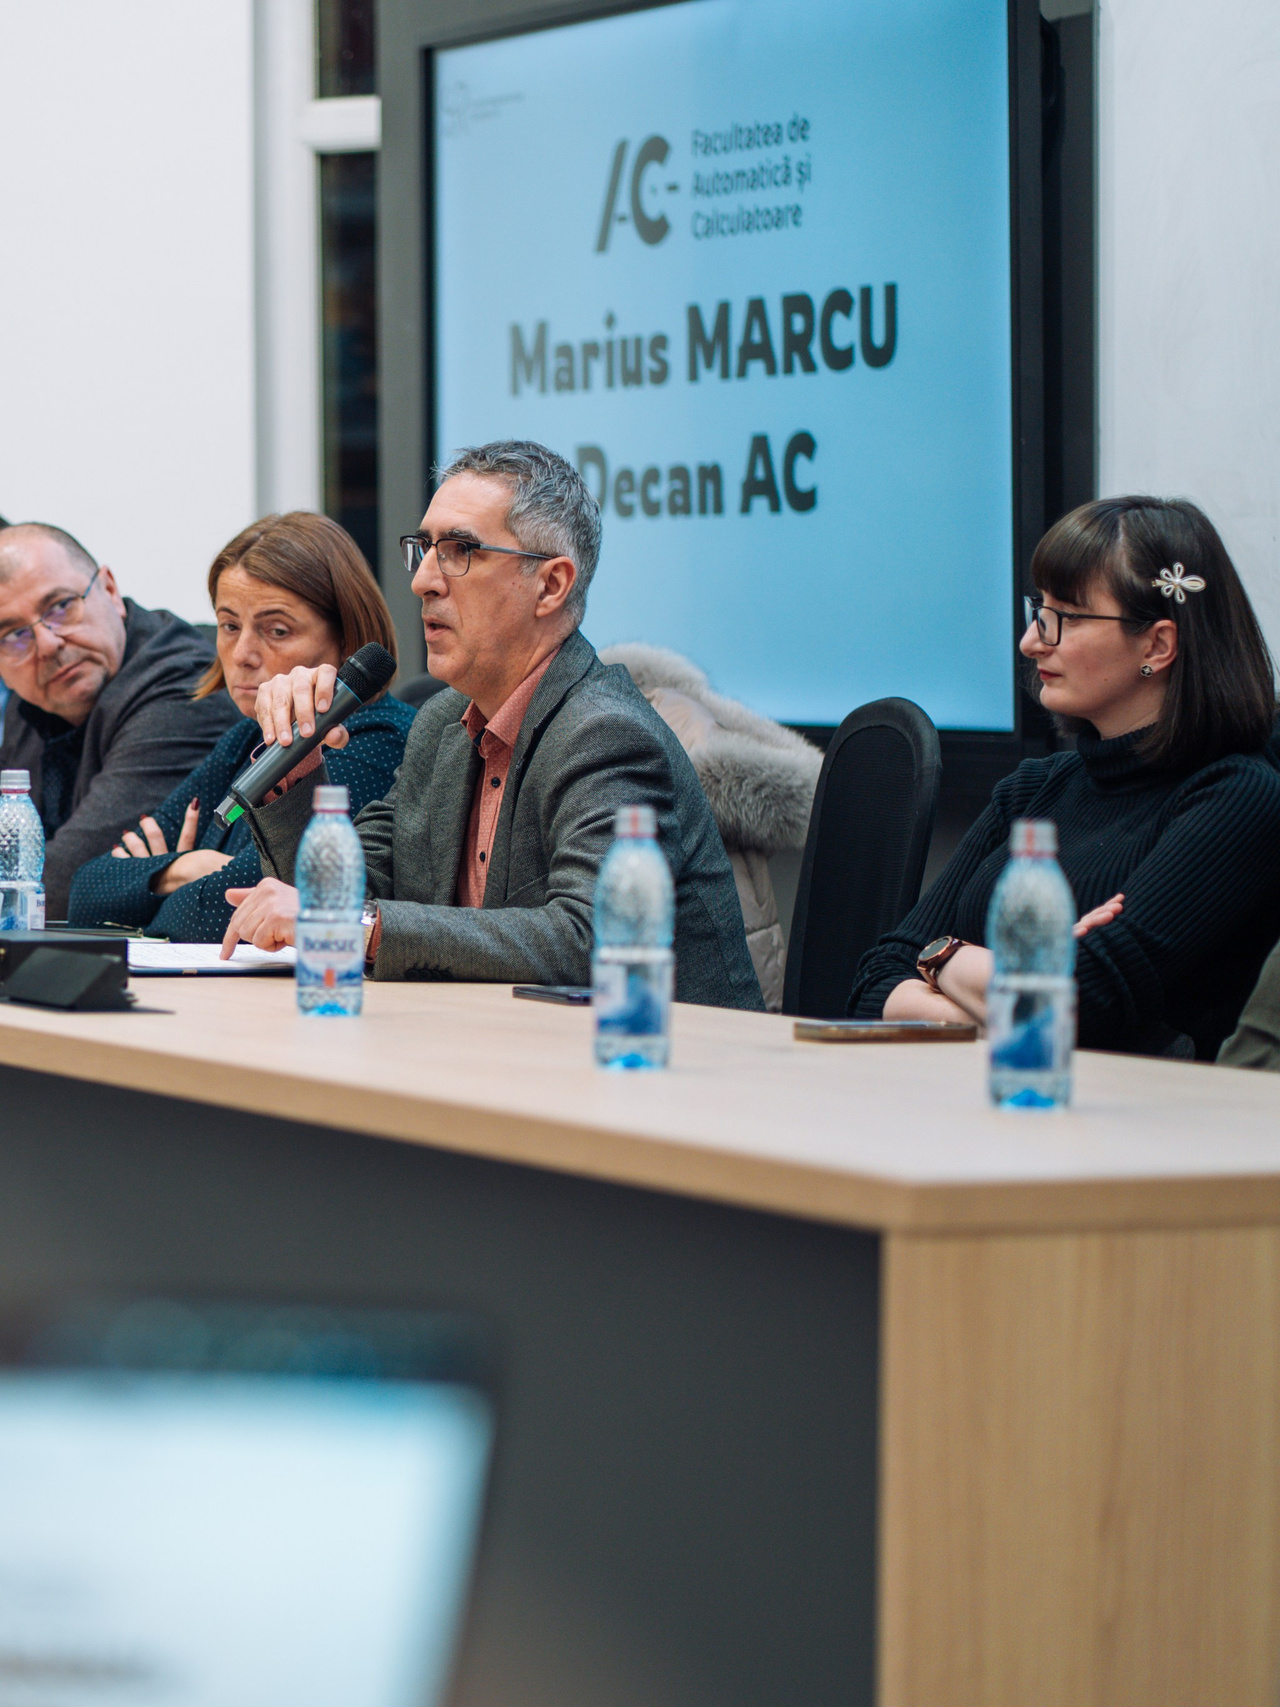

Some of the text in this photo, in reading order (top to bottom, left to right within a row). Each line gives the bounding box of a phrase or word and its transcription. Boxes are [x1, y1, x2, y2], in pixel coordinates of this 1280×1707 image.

[691, 113, 810, 156] Facultatea de
[691, 154, 791, 198] Automatică
[691, 203, 803, 241] Calculatoare
[510, 282, 898, 396] Marius MARCU
[576, 430, 817, 519] Decan AC
